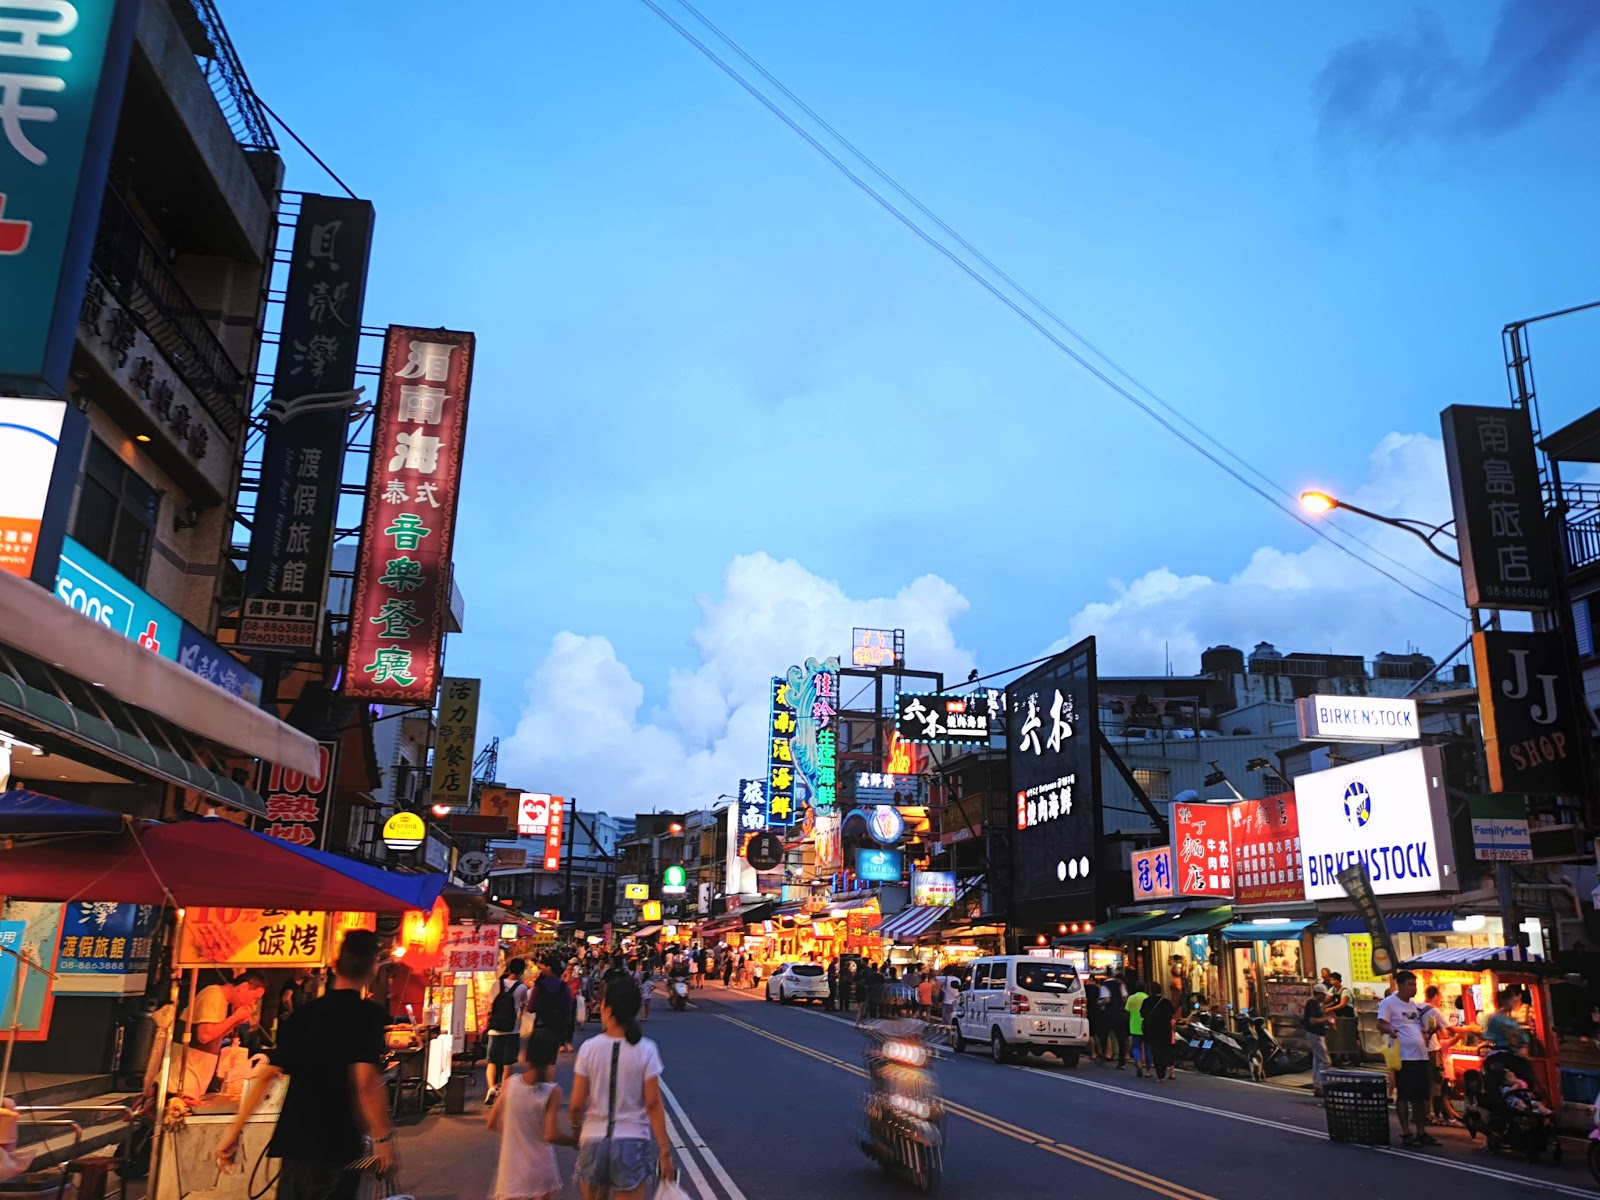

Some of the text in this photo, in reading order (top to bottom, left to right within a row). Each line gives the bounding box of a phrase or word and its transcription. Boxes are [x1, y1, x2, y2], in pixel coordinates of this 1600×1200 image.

[381, 478, 442, 509] 泰式
[1475, 416, 1532, 582] 南島旅店
[281, 447, 323, 593] 渡假旅館
[266, 562, 279, 593] Hotel
[362, 513, 432, 688] 音樂餐廳
[1319, 706, 1413, 728] BIRKENSTOCK
[1509, 731, 1567, 771] SHOP
[264, 793, 320, 848] 熱炒
[389, 821, 417, 830] Corona
[1473, 825, 1529, 838] FamilyMart
[1178, 806, 1207, 893] 墾丁麵店
[1207, 838, 1219, 889] 牛肉麵
[1137, 852, 1171, 892] 冠利
[62, 936, 127, 960] 渡假旅館
[258, 923, 319, 957] 碳烤
[60, 961, 125, 970] 08-8863888
